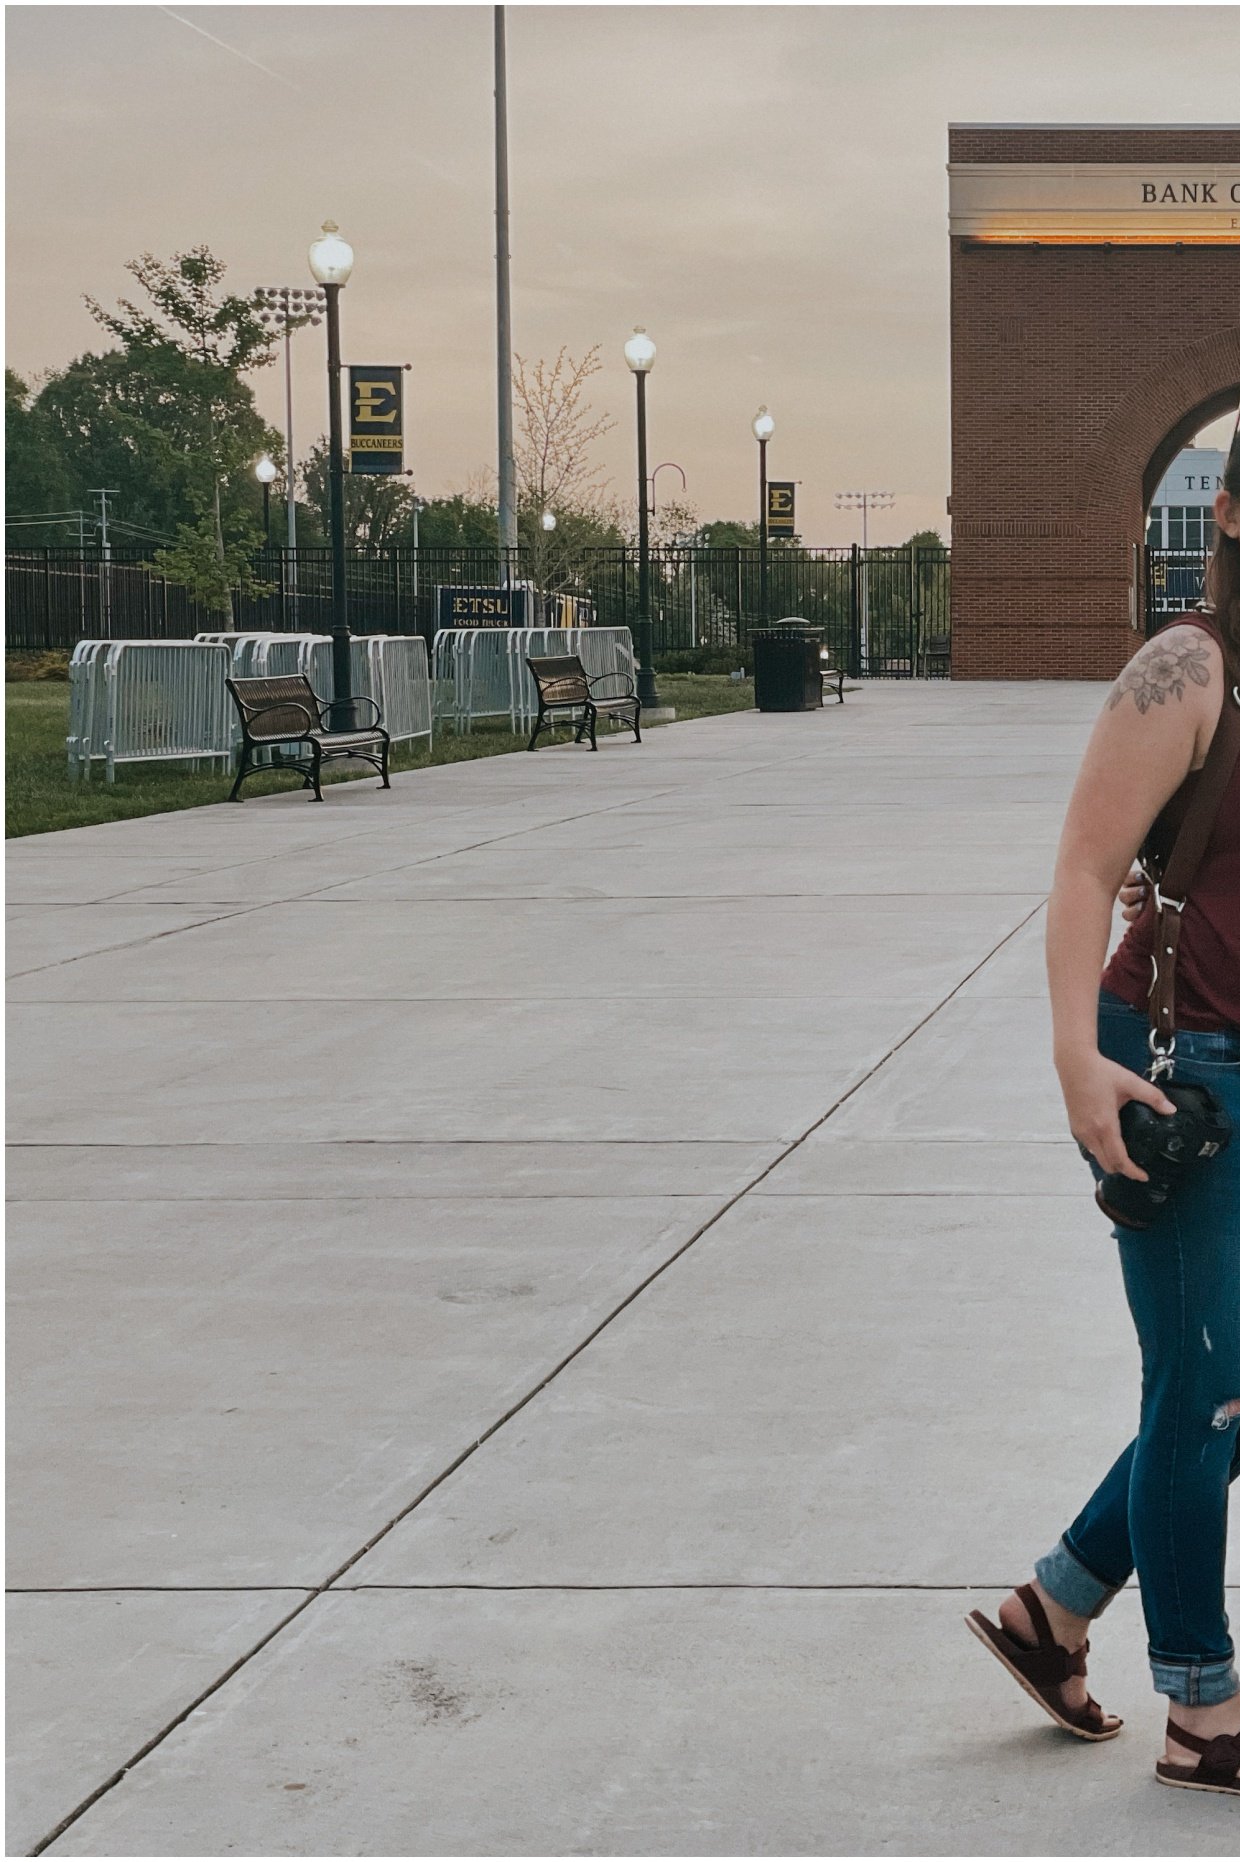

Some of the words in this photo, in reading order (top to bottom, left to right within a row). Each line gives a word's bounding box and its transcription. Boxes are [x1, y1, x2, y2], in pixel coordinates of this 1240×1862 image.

[1141, 182, 1219, 203] BANK
[354, 381, 397, 423] E
[351, 438, 403, 449] BUCCANEERS
[770, 489, 792, 511] E
[453, 597, 508, 614] ETSU
